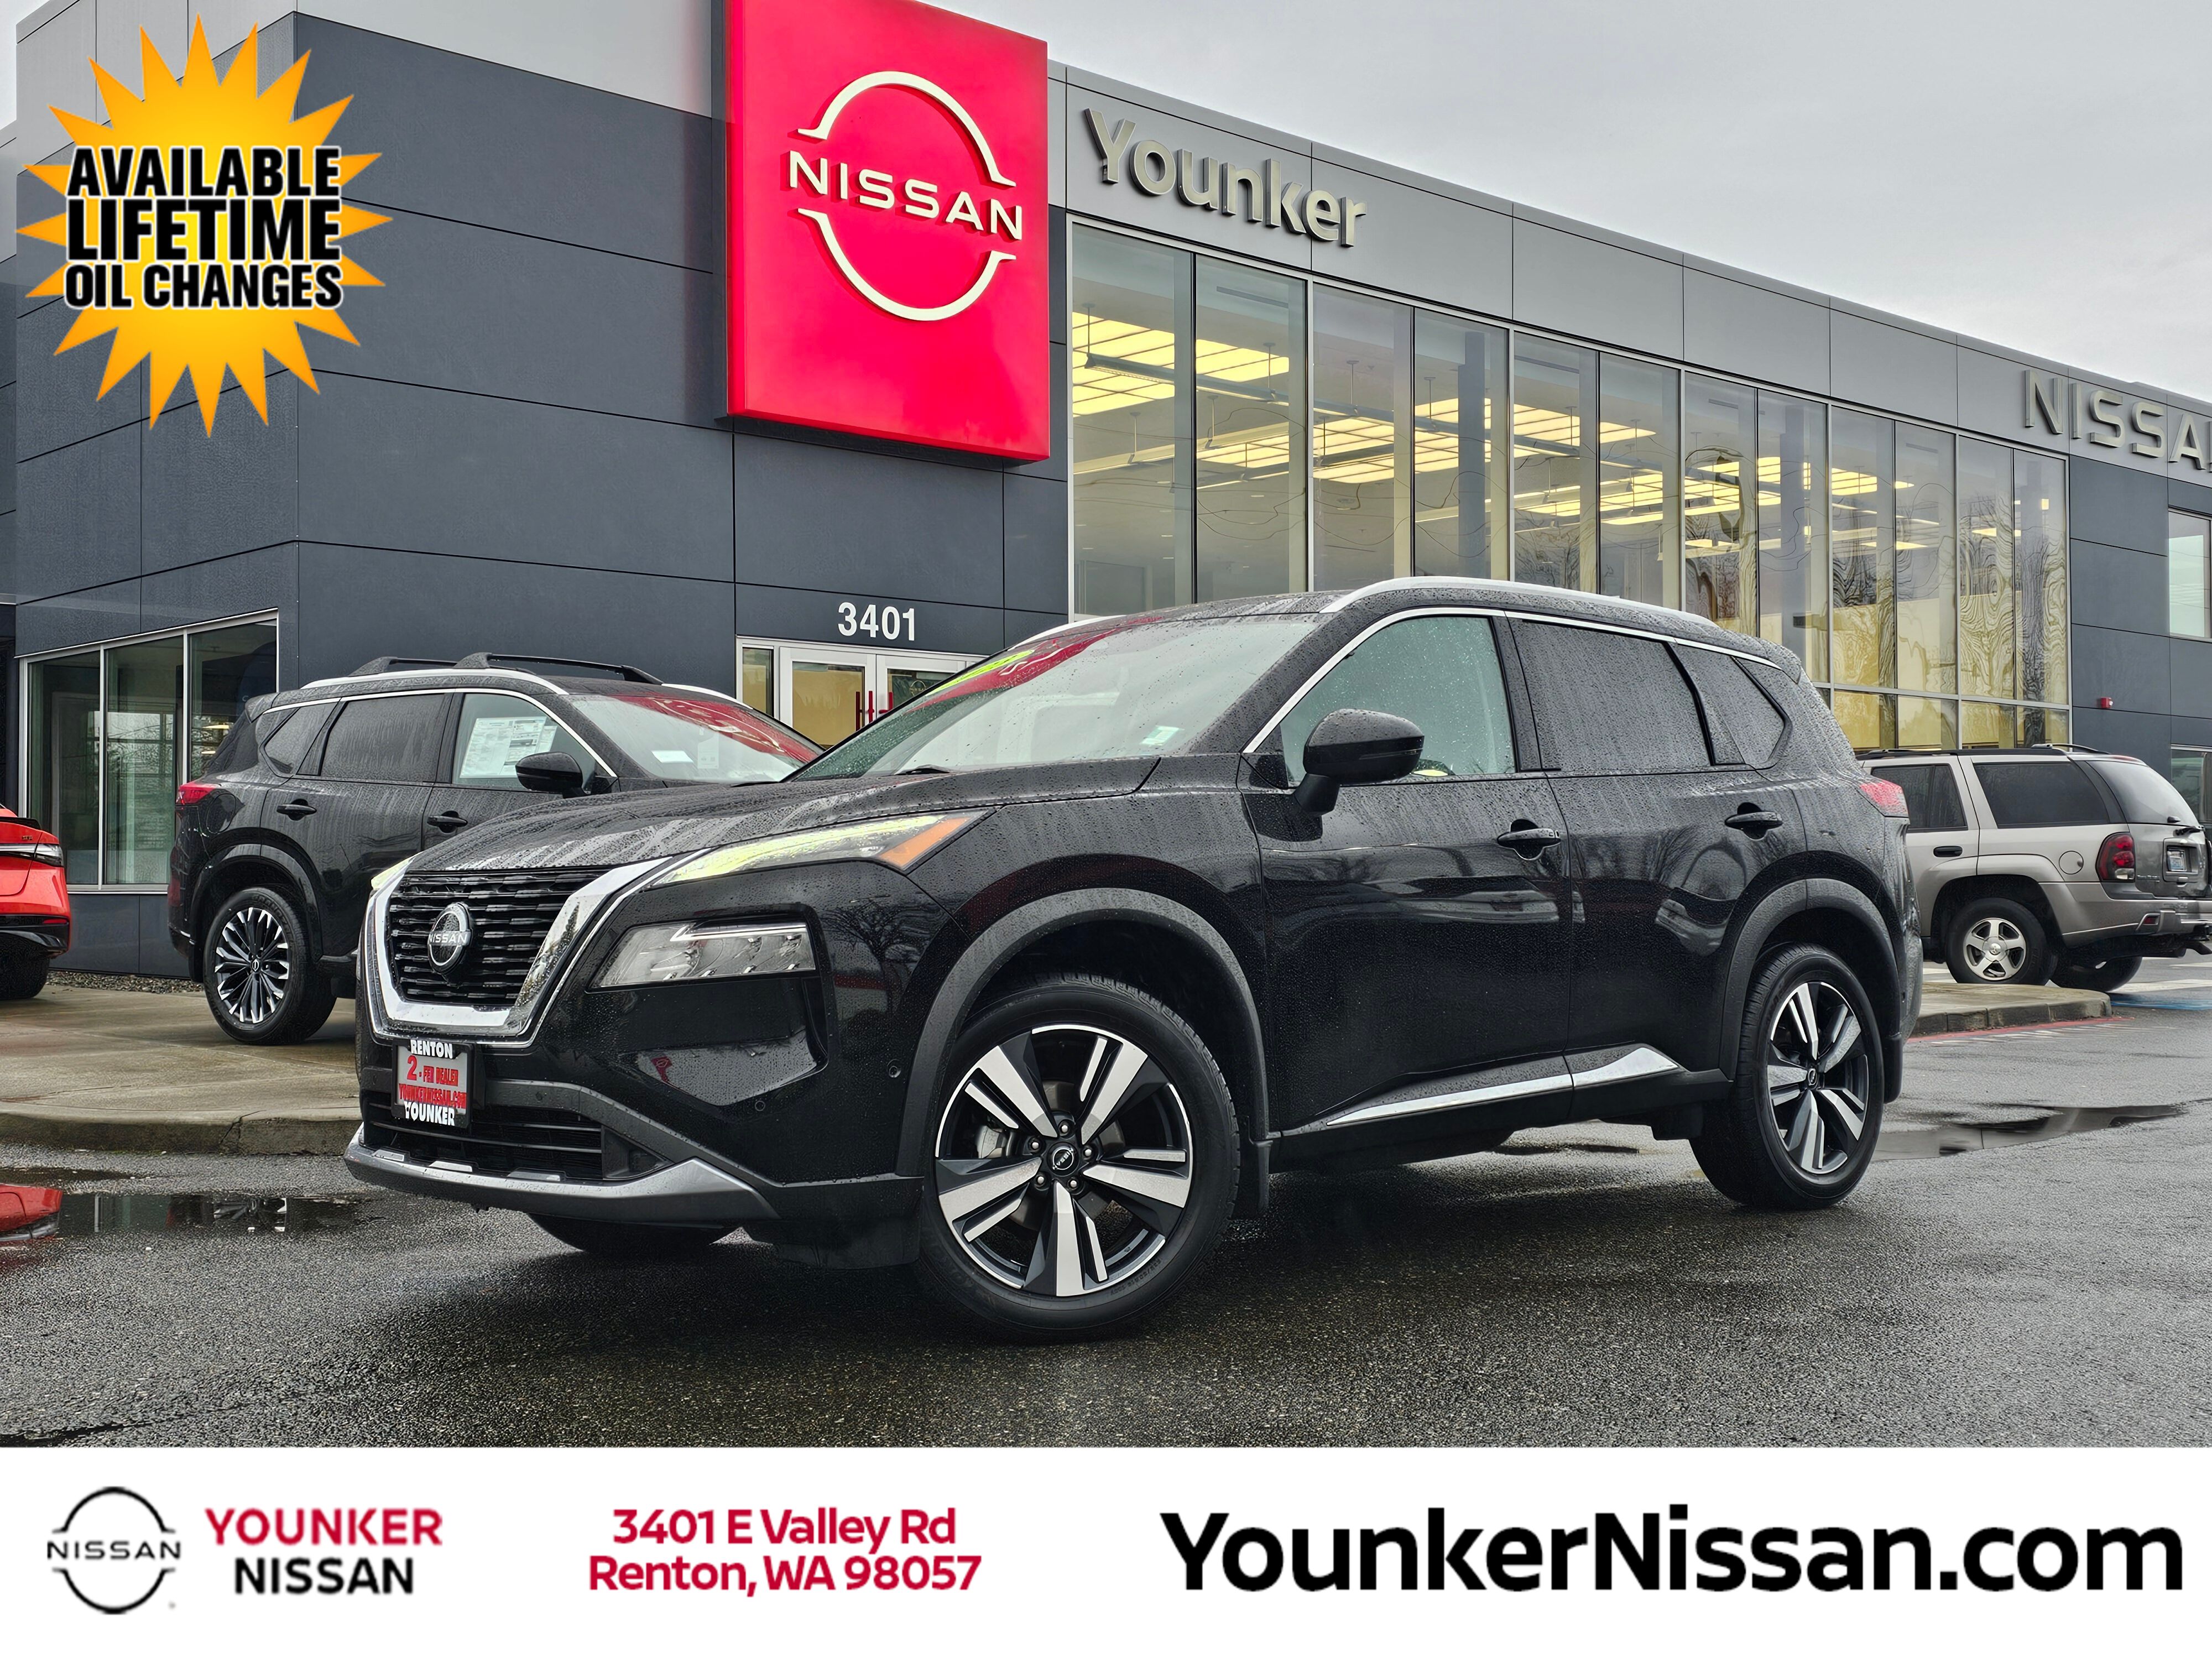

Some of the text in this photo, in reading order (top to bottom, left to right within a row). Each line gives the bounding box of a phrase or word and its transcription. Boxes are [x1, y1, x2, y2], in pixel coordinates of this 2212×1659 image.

[789, 150, 1022, 241] NISSAN
[1084, 108, 1368, 248] Younker
[2025, 369, 2212, 474] NISSA
[838, 602, 915, 641] 3401
[429, 933, 467, 943] NISSAN
[410, 1040, 453, 1059] RENTON
[404, 1101, 455, 1126] YOUNKER
